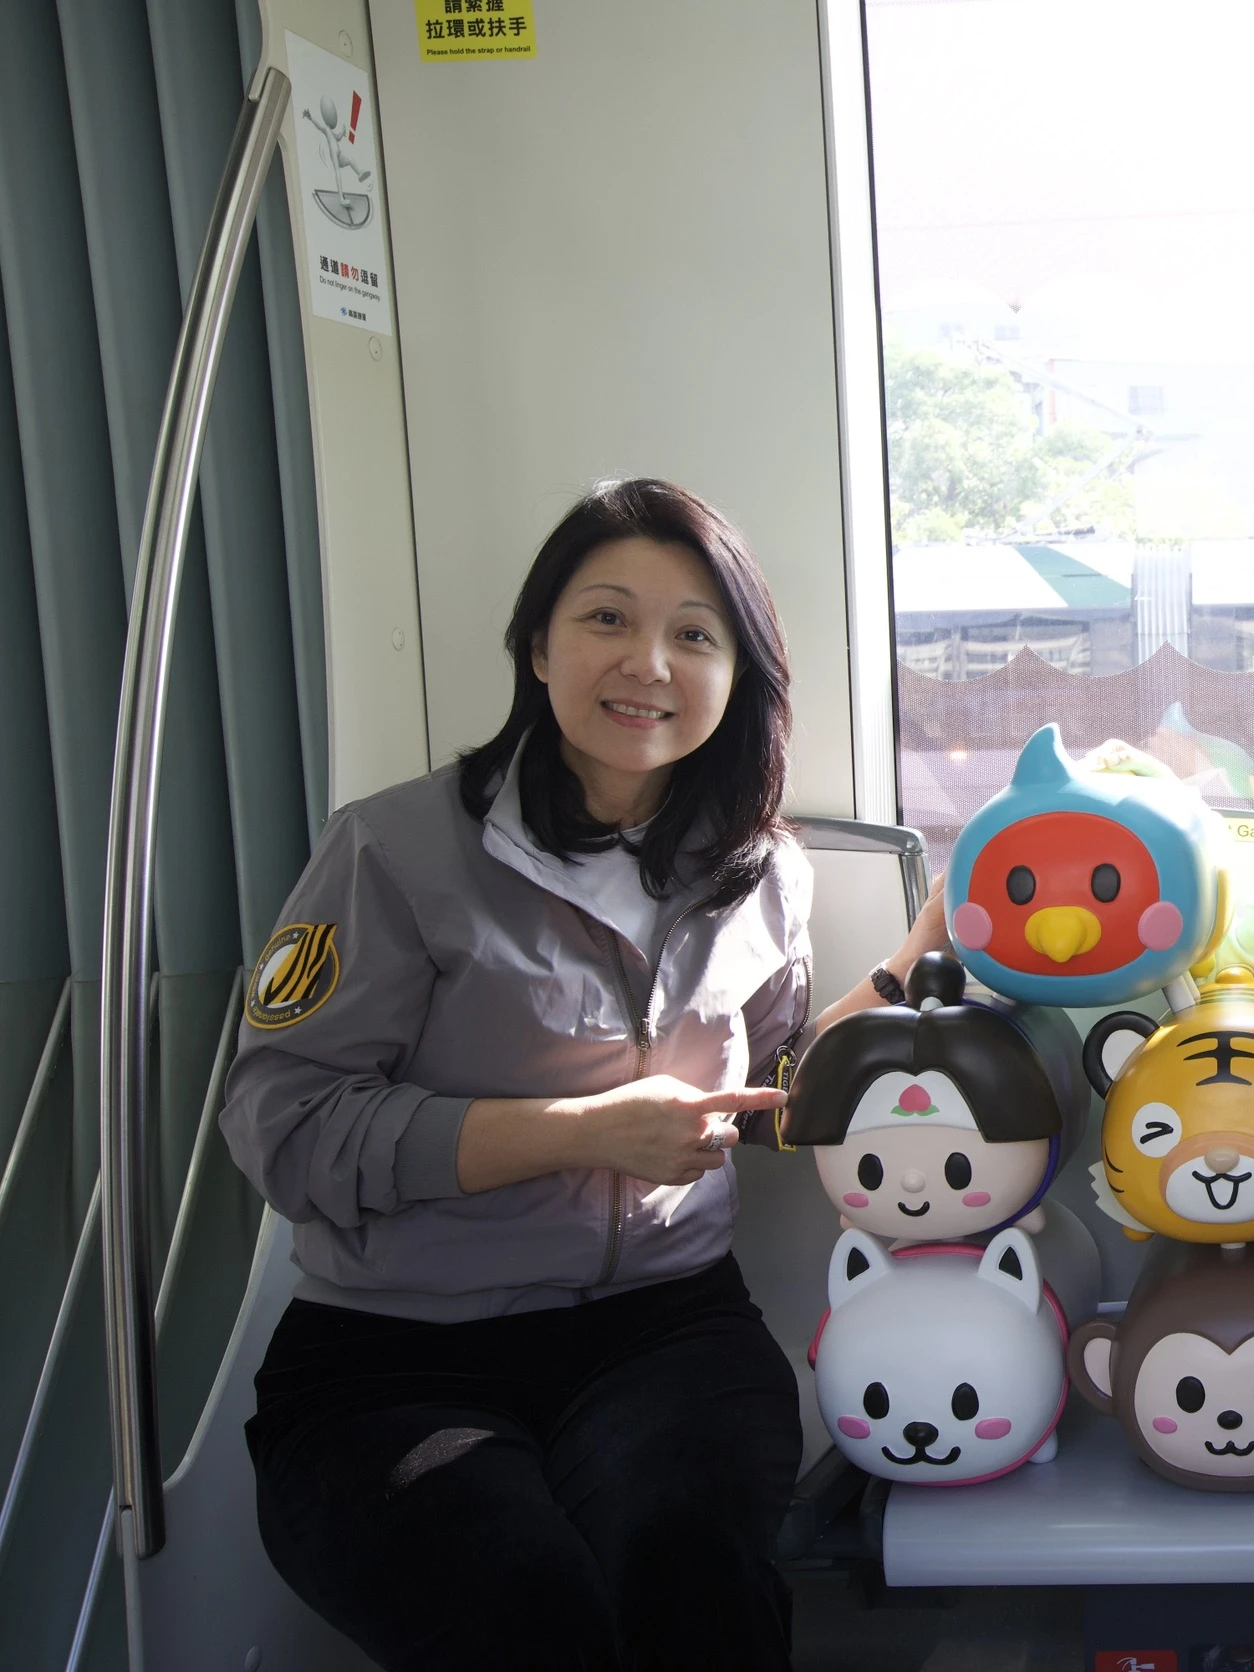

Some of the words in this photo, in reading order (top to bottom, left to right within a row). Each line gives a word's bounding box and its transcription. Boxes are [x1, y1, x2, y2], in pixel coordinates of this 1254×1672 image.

[425, 16, 527, 39] 拉環或扶手
[426, 48, 448, 56] Please
[477, 47, 495, 55] strap
[504, 45, 531, 53] handrail
[320, 255, 378, 288] 通道請勿逗留
[319, 275, 327, 285] Do
[335, 281, 347, 291] linger
[361, 290, 381, 302] gangway
